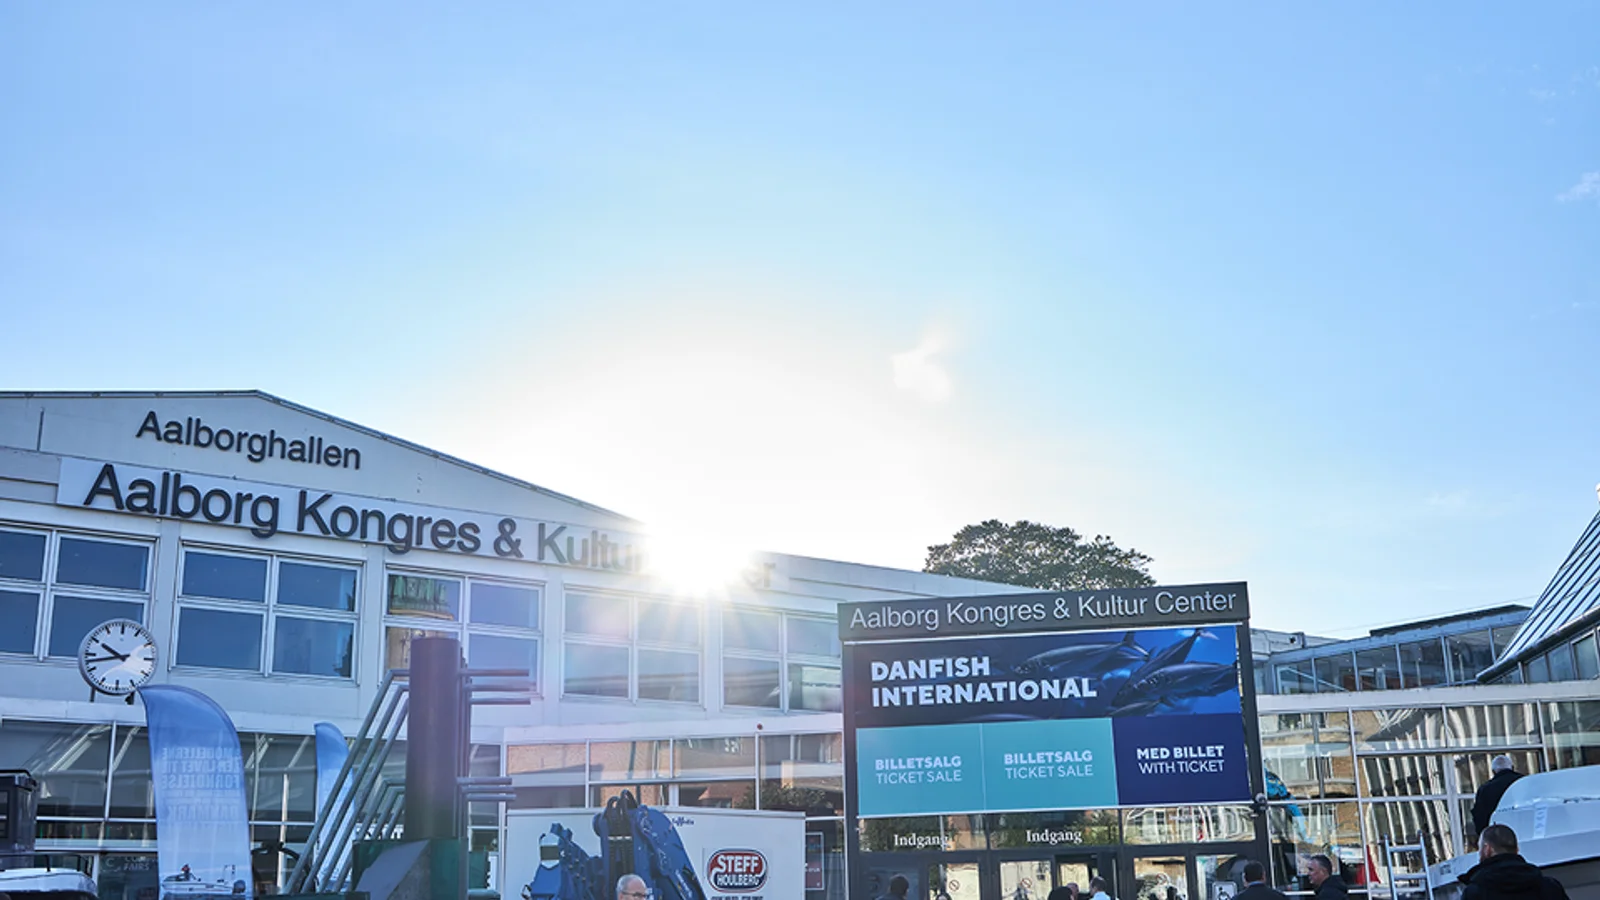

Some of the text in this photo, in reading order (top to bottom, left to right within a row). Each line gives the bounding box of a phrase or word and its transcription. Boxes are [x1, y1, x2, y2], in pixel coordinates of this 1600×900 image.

[136, 411, 361, 471] Aalborghallen
[84, 463, 280, 538] Aalborg
[296, 490, 481, 555] Kongres
[493, 518, 524, 558] &
[850, 591, 1236, 631] Aalborg Kongres & Kultur Center
[871, 656, 990, 682] DANFISH
[872, 678, 1097, 708] INTERNATIONAL
[1004, 750, 1093, 766] BILLETSALG
[1136, 745, 1224, 761] MED BILLET
[875, 755, 962, 771] BILLETSALG
[1005, 764, 1094, 780] TICKET SALE
[1138, 760, 1224, 774] WITH TICKET
[876, 769, 963, 785] TICKET SALE
[893, 828, 1082, 848] Indgang Indgang
[714, 854, 760, 874] STEFF
[717, 874, 760, 886] HOULBERG
